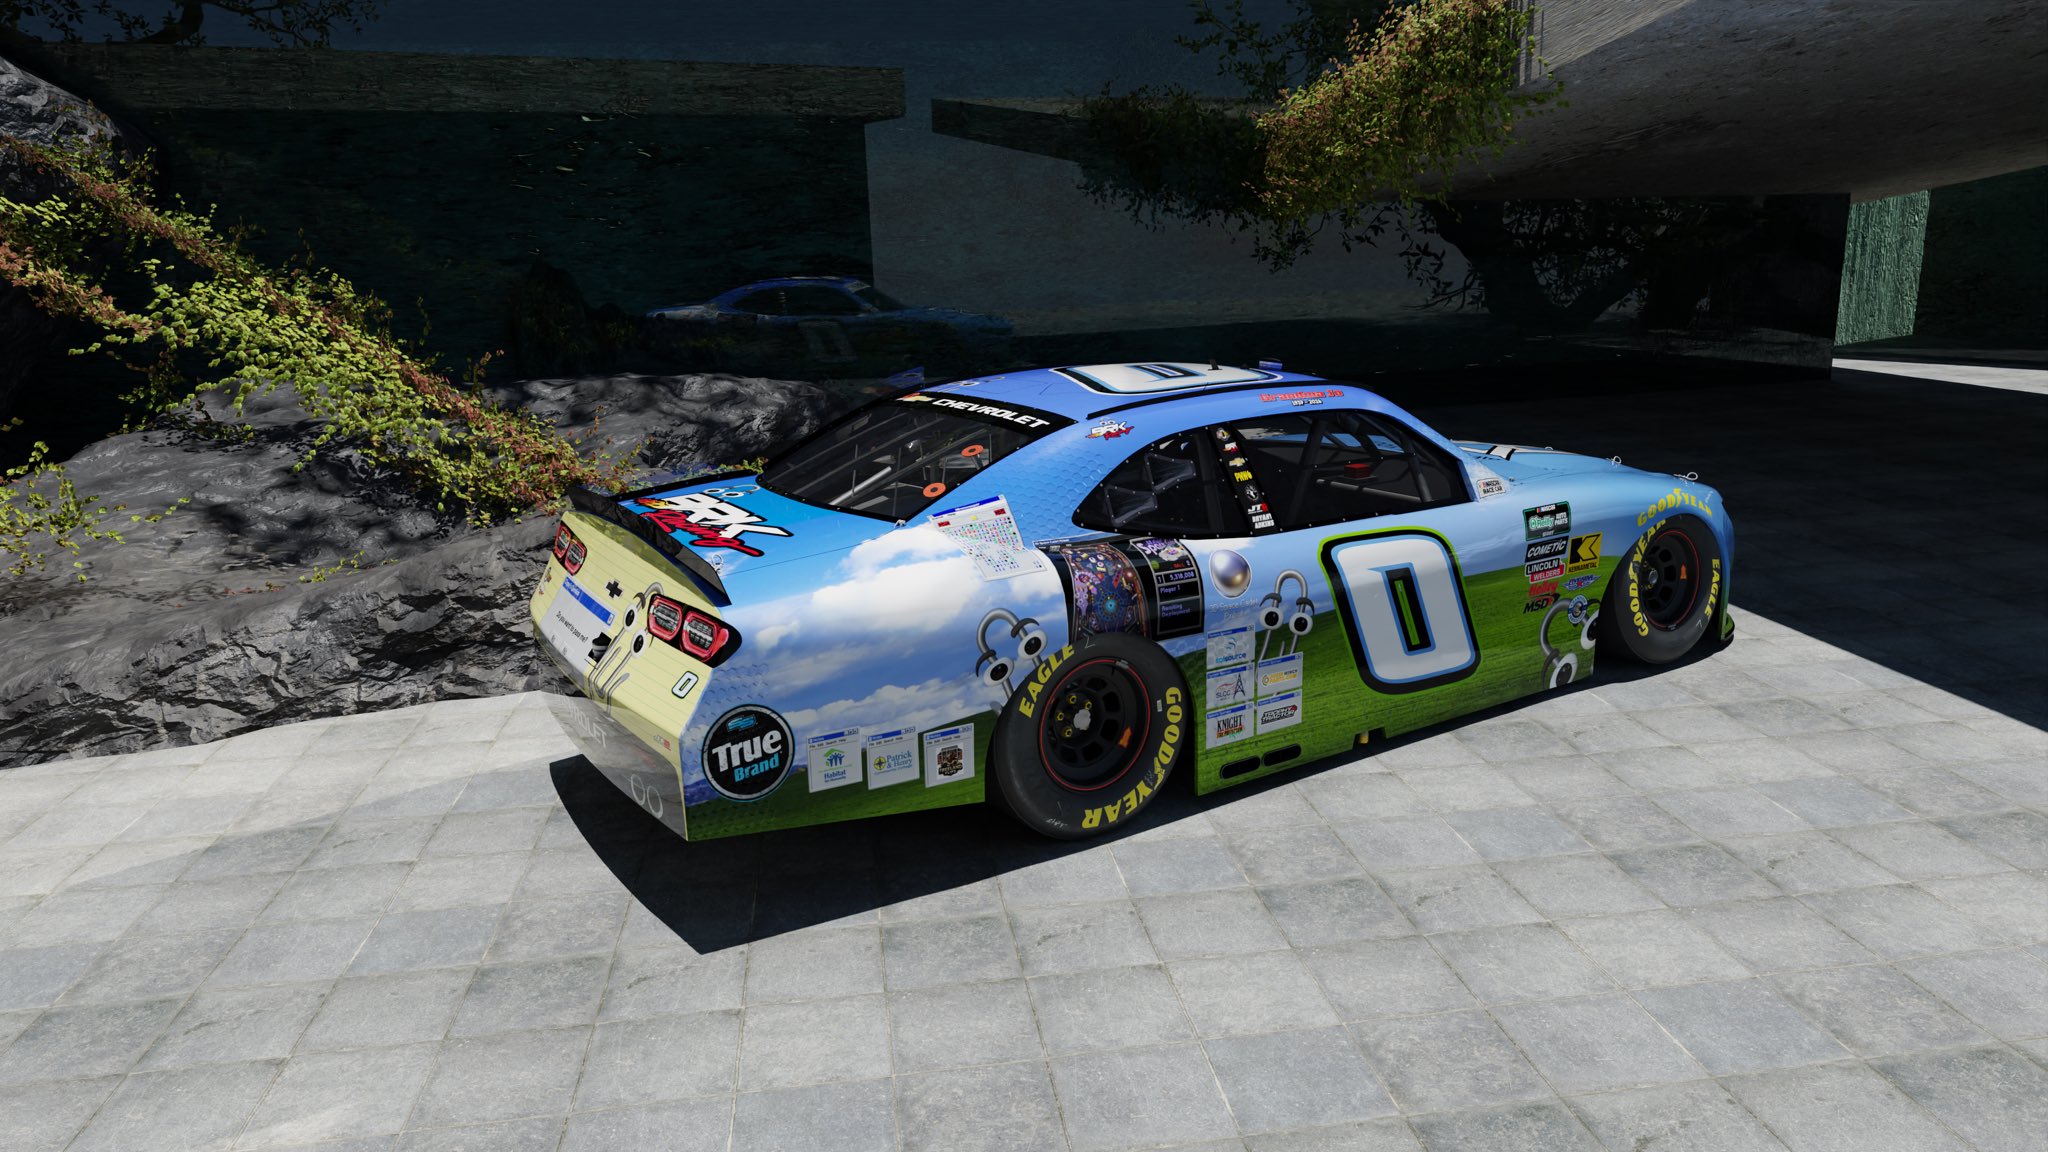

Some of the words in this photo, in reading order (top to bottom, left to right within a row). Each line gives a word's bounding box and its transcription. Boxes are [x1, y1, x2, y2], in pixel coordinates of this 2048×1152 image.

[931, 398, 1051, 429] CHEVROLET
[1555, 512, 1567, 520] AUTO
[1637, 488, 1713, 528] GOODYEAR
[1554, 517, 1568, 526] PARTS
[1527, 539, 1566, 558] COMETIC
[1527, 558, 1558, 574] LINCOLN
[1533, 569, 1560, 581] WELDERS
[1568, 561, 1597, 574] KENNAMETAL
[1704, 558, 1721, 620] EAGLE
[1320, 528, 1482, 694] 0
[1523, 597, 1551, 614] MSD
[671, 670, 699, 699] 0
[1018, 644, 1075, 718] EAGLE
[1217, 715, 1243, 732] KNIGHT
[711, 730, 782, 772] True
[886, 750, 912, 763] Patrick
[1081, 686, 1183, 829] GOODYEAR
[734, 752, 780, 782] Brand
[893, 758, 913, 768] Henry
[824, 769, 847, 779] Habitat
